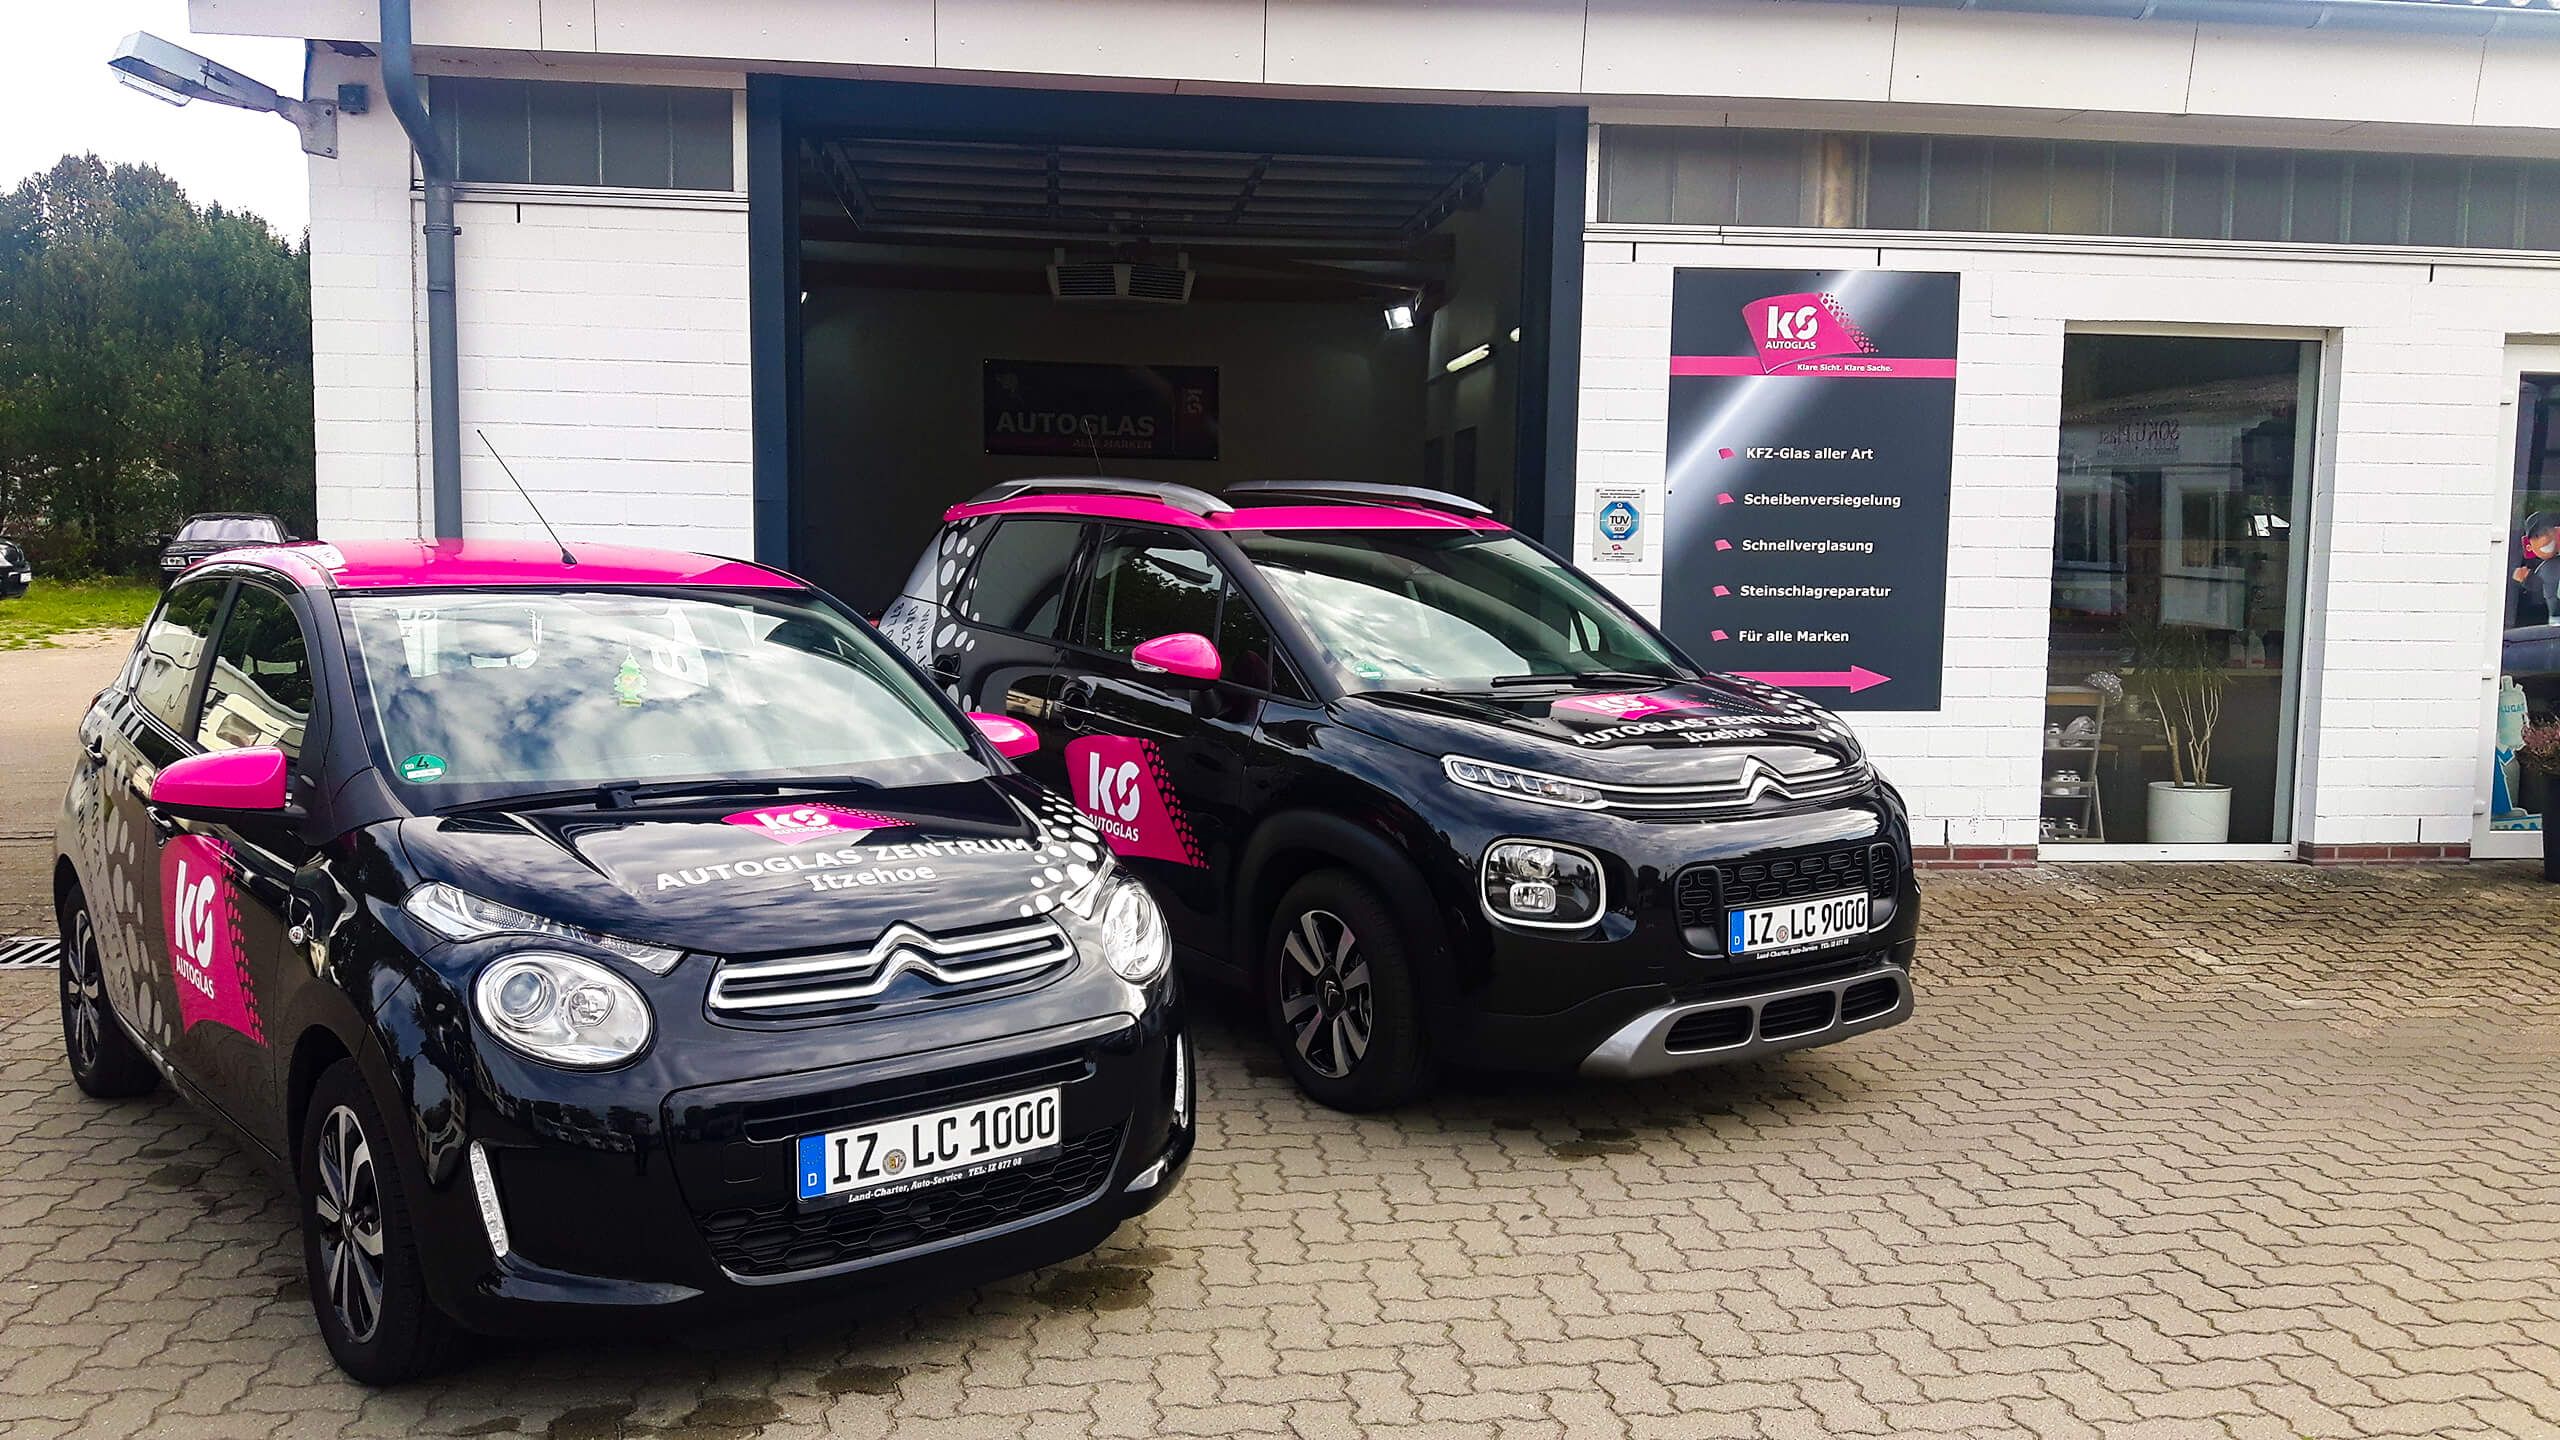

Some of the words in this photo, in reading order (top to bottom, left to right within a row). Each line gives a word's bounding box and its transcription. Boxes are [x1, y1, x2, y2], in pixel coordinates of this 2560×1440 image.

[1765, 341, 1817, 350] AUTOGLAS
[1797, 364, 1818, 372] Klare
[1819, 364, 1842, 372] Sicht.
[1844, 364, 1865, 372] Klare
[1866, 364, 1893, 373] Sache.
[996, 411, 1155, 436] AUTOGLAS
[1746, 447, 1811, 460] KFZ-Glas
[1814, 447, 1848, 460] aller
[1850, 448, 1874, 460] Art
[1743, 493, 1902, 508] Scheibenversiegelung
[1742, 539, 1874, 554] Schnellverglasung
[1740, 585, 1892, 599] Steinschlagreparatur
[1738, 630, 1763, 642] Für
[1766, 630, 1793, 642] alle
[1796, 630, 1850, 642] Marken
[1571, 718, 1707, 745] AUTOGLAS
[1704, 715, 1821, 726] ZENTRUM
[1678, 728, 1768, 743] Itzehoe
[656, 844, 863, 891] AUTOGLAS
[875, 836, 1032, 863] ZENTRUM
[803, 864, 937, 893] Itzehoe
[1747, 912, 1774, 946] IZ
[1791, 906, 1817, 939] LC
[1821, 898, 1866, 936] 9000
[1734, 936, 1741, 946] D
[175, 955, 216, 1000] AUTOGLAS
[832, 1132, 880, 1185] IZ
[912, 1116, 959, 1168] LC
[969, 1096, 1055, 1156] 1000
[807, 1172, 818, 1187] D
[848, 1183, 911, 1203] Land-Charter,
[910, 1171, 963, 1190] Auto-Service
